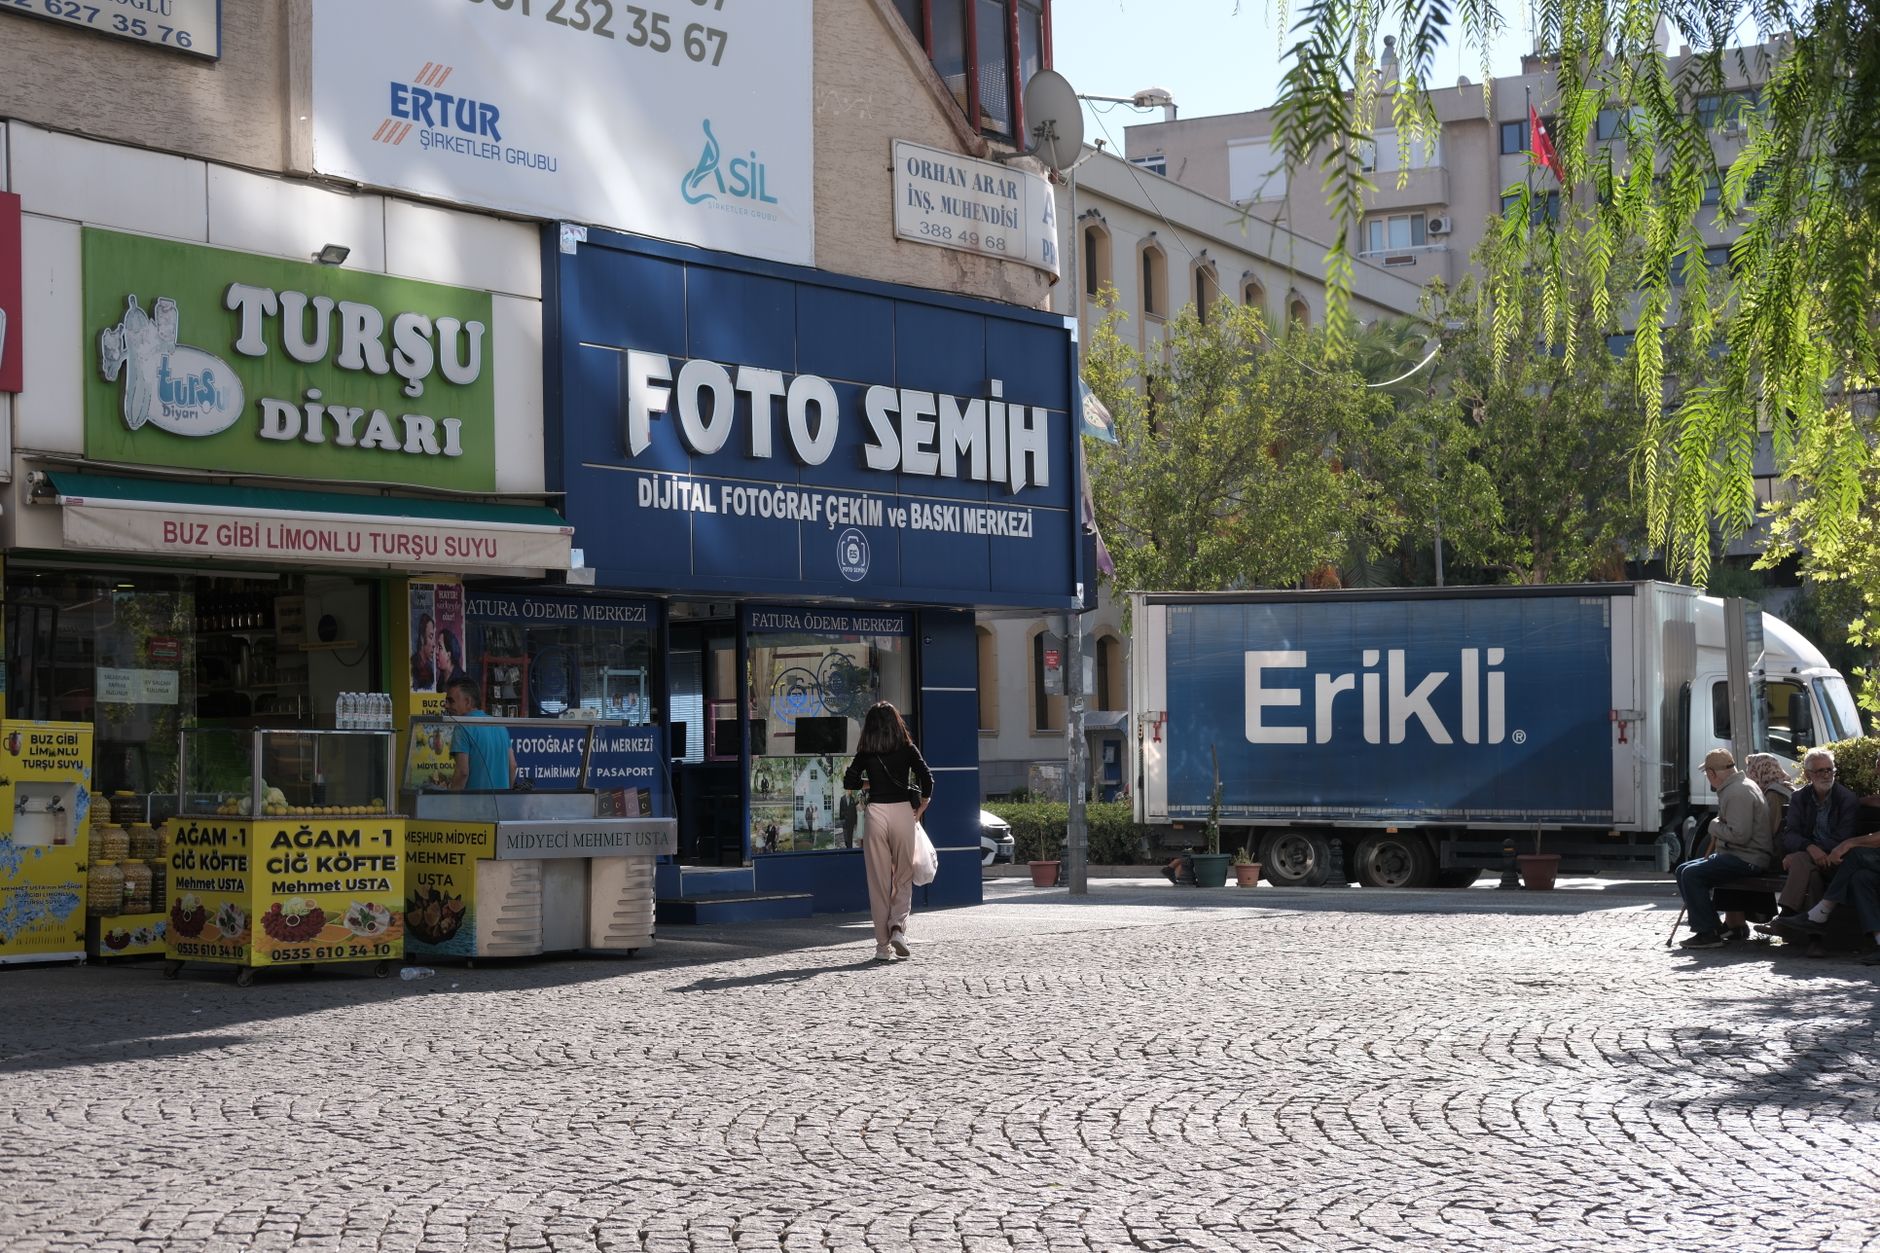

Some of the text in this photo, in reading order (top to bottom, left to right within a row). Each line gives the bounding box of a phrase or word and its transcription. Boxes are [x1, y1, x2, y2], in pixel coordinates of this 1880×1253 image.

[44, 0, 193, 48] 627 35 76
[625, 4, 671, 53] 35
[683, 22, 728, 67] 67
[390, 81, 502, 143] ERTUR
[419, 127, 557, 173] ŞİRKETLER GRUBU
[907, 156, 1018, 201] ORHAN ARAR
[919, 221, 1007, 251] 388 49 68
[226, 282, 485, 398] TURŞU
[259, 388, 463, 457] DİYARI
[625, 348, 1049, 496] FOTO SEMİH
[638, 473, 1033, 538] DİJİTAL FOTOĞRAF ÇEKİM ve BASKI MERKEZİ
[163, 520, 497, 560] BUZ GİBİ LİMONLU TURŞU SUYU
[464, 599, 518, 618] ATURA
[522, 599, 578, 619] ÖDEME
[582, 604, 647, 622] MERKEZİ
[751, 612, 904, 633] FATURA ÖDEME MERKEZİ
[1245, 648, 1505, 745] Erikli
[30, 732, 78, 745] BUZ GİBİ
[516, 735, 574, 753] FOTOĞRAF
[577, 735, 608, 756] ÇKİM
[610, 735, 654, 753] MERKEZİ
[29, 745, 79, 757] LİMNLU
[22, 759, 83, 771] TURŞU SUYU
[534, 765, 592, 779] İZMİRİMKAT
[596, 766, 654, 778] PASAPORT
[175, 822, 227, 847] AĞAM
[270, 825, 361, 849] AĞAM
[404, 829, 487, 847] MEŞHUR MİDYECİ
[507, 830, 669, 850] MİDYECİ MEHMET USTA
[200, 850, 247, 872] KÖFTE
[316, 852, 397, 873] KÖFTE
[406, 851, 466, 867] MEHMET
[176, 876, 244, 891] Mehmet USTA
[271, 877, 390, 893] Mehmet USTA
[417, 873, 454, 887] USTA
[177, 942, 243, 958] 0535 610 34 10
[272, 943, 390, 961] 0535 610 34 10
